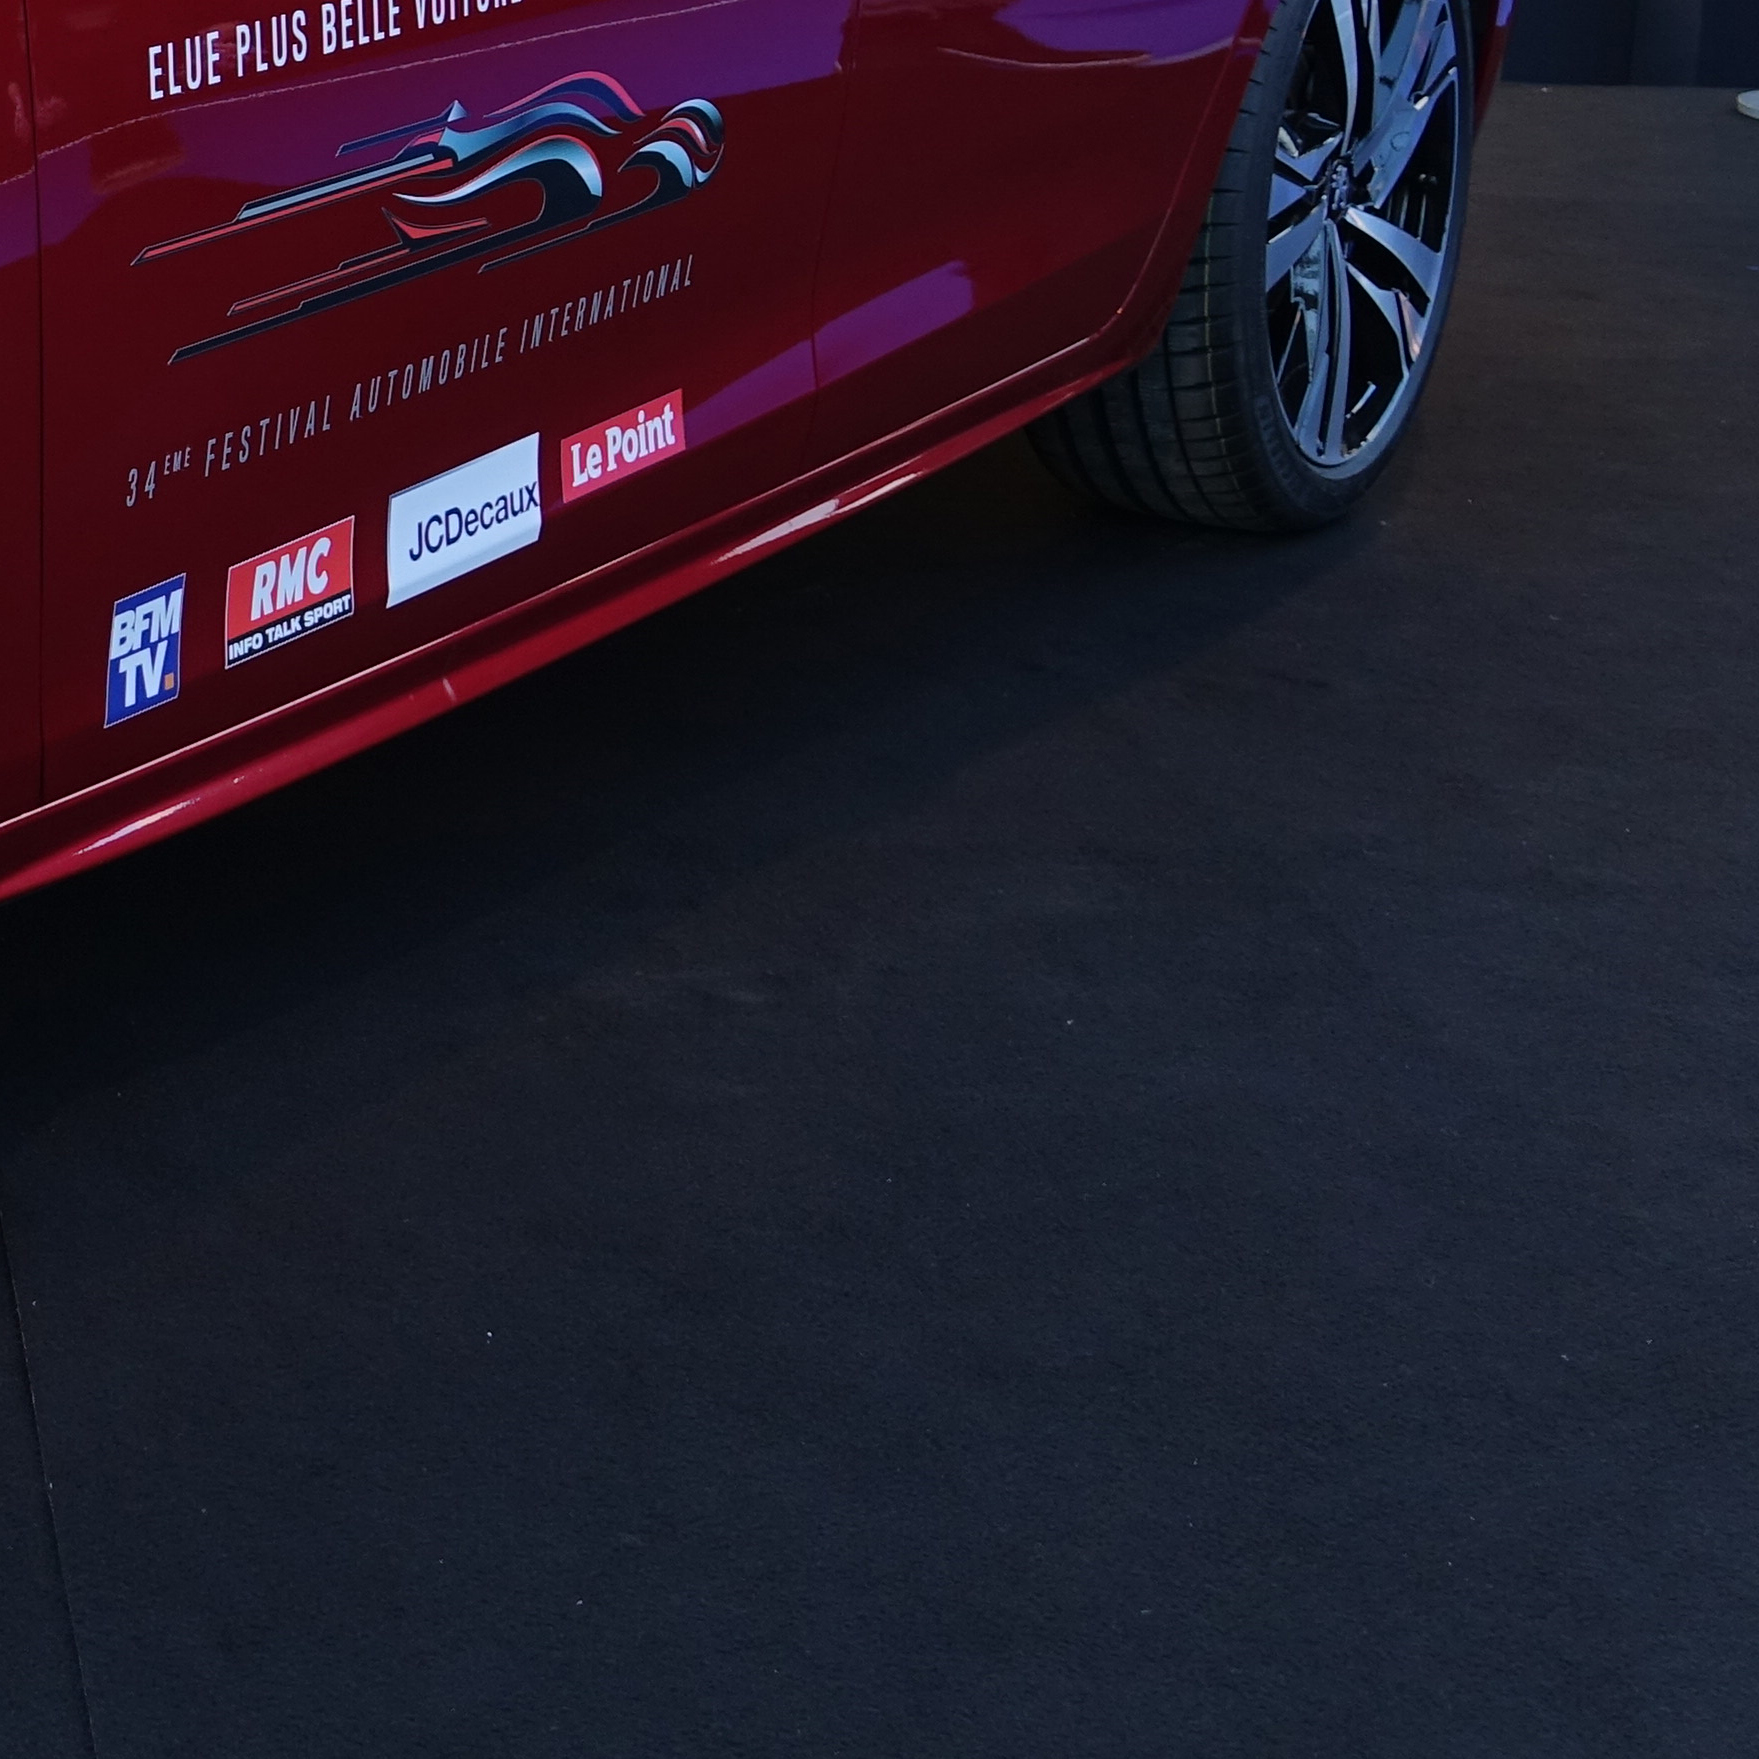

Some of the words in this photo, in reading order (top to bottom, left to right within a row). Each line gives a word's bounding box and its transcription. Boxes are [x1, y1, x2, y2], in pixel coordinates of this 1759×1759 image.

[147, 29, 222, 100] ELUE
[236, 9, 307, 77] PLUS
[204, 395, 331, 478] FESTIVAL
[349, 327, 506, 420] AUTOMOBILE
[520, 254, 694, 355] INTERNATIONAL
[570, 440, 602, 487] Le
[605, 403, 676, 473] Point
[408, 479, 539, 562] JCDecaux
[250, 536, 332, 622] RMC
[110, 588, 183, 661] BFM
[229, 632, 263, 661] INFO
[265, 620, 302, 644] TALK
[303, 594, 351, 628] SPORT
